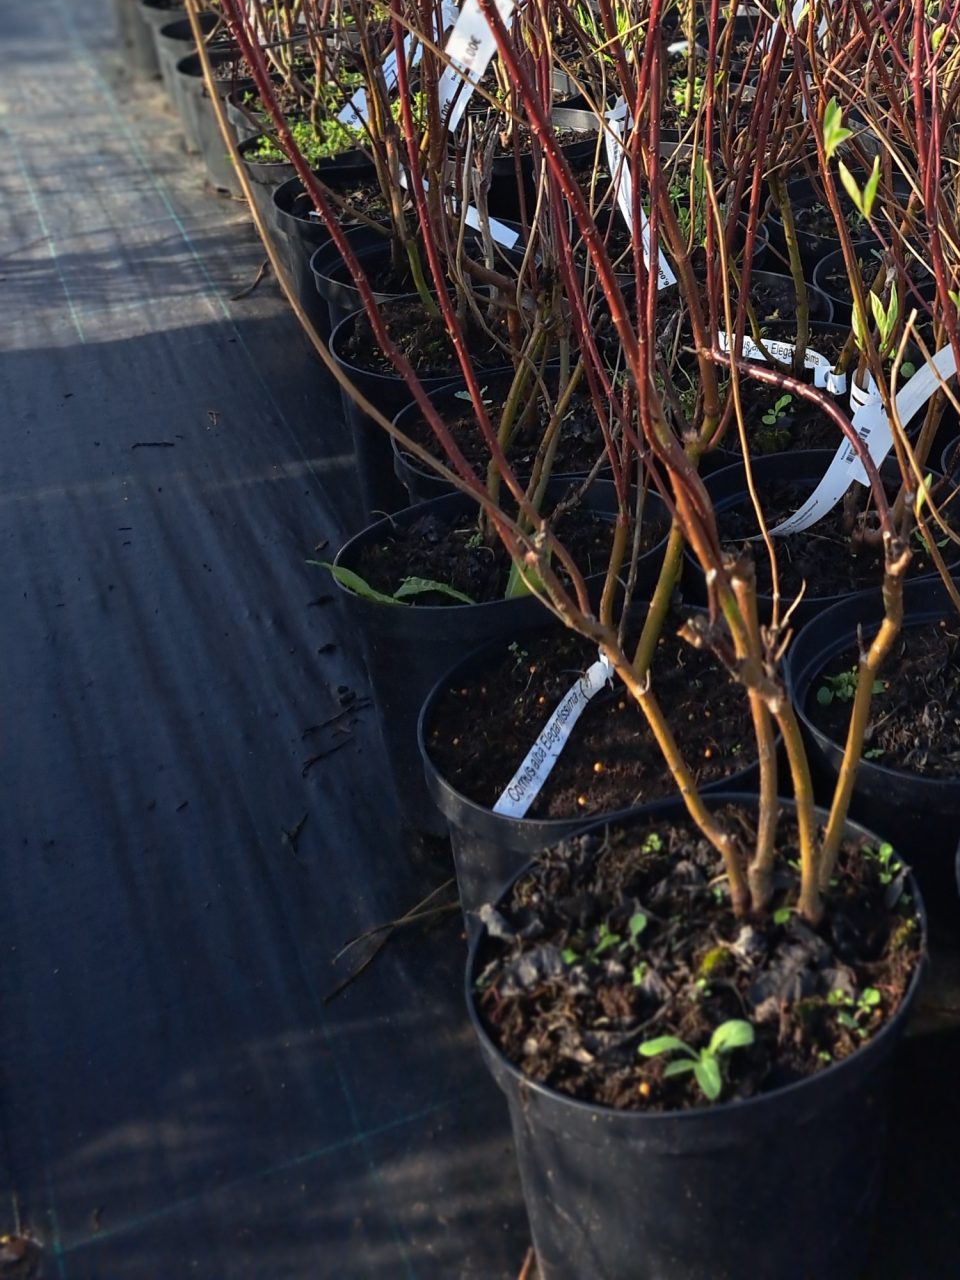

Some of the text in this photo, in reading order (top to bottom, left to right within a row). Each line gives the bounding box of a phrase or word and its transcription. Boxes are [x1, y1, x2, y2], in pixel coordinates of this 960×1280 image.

[770, 342, 820, 365] Elegasima
[508, 691, 579, 802] Cornus alba Elegantissima
